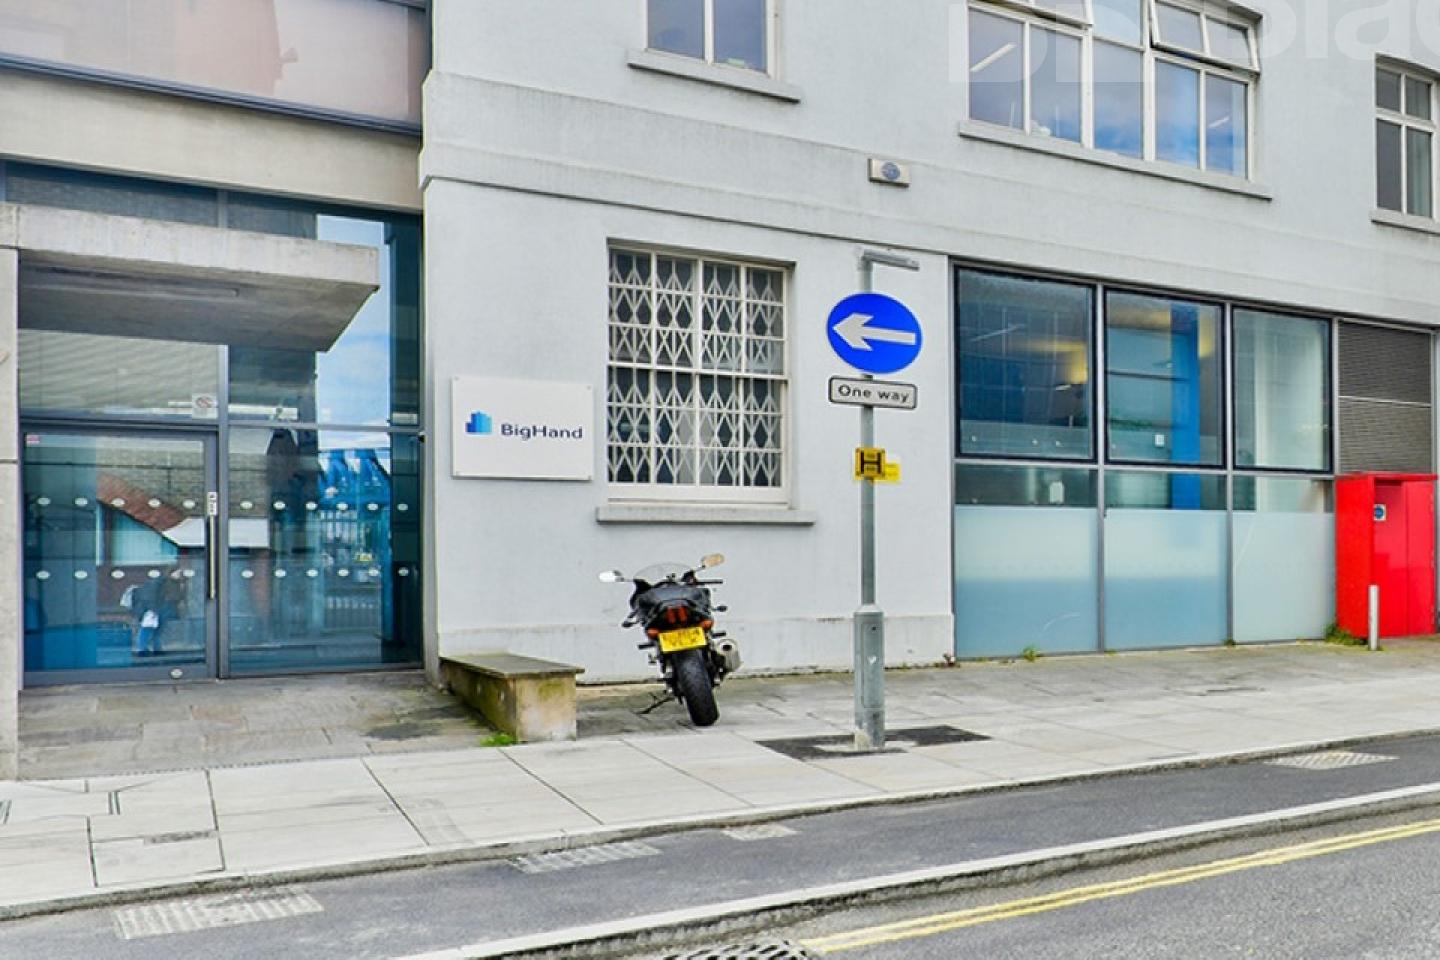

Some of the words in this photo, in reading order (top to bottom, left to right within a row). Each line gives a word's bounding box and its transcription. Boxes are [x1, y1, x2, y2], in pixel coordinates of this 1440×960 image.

[838, 384, 871, 398] One
[878, 391, 909, 402] way
[501, 423, 583, 441] BigHand
